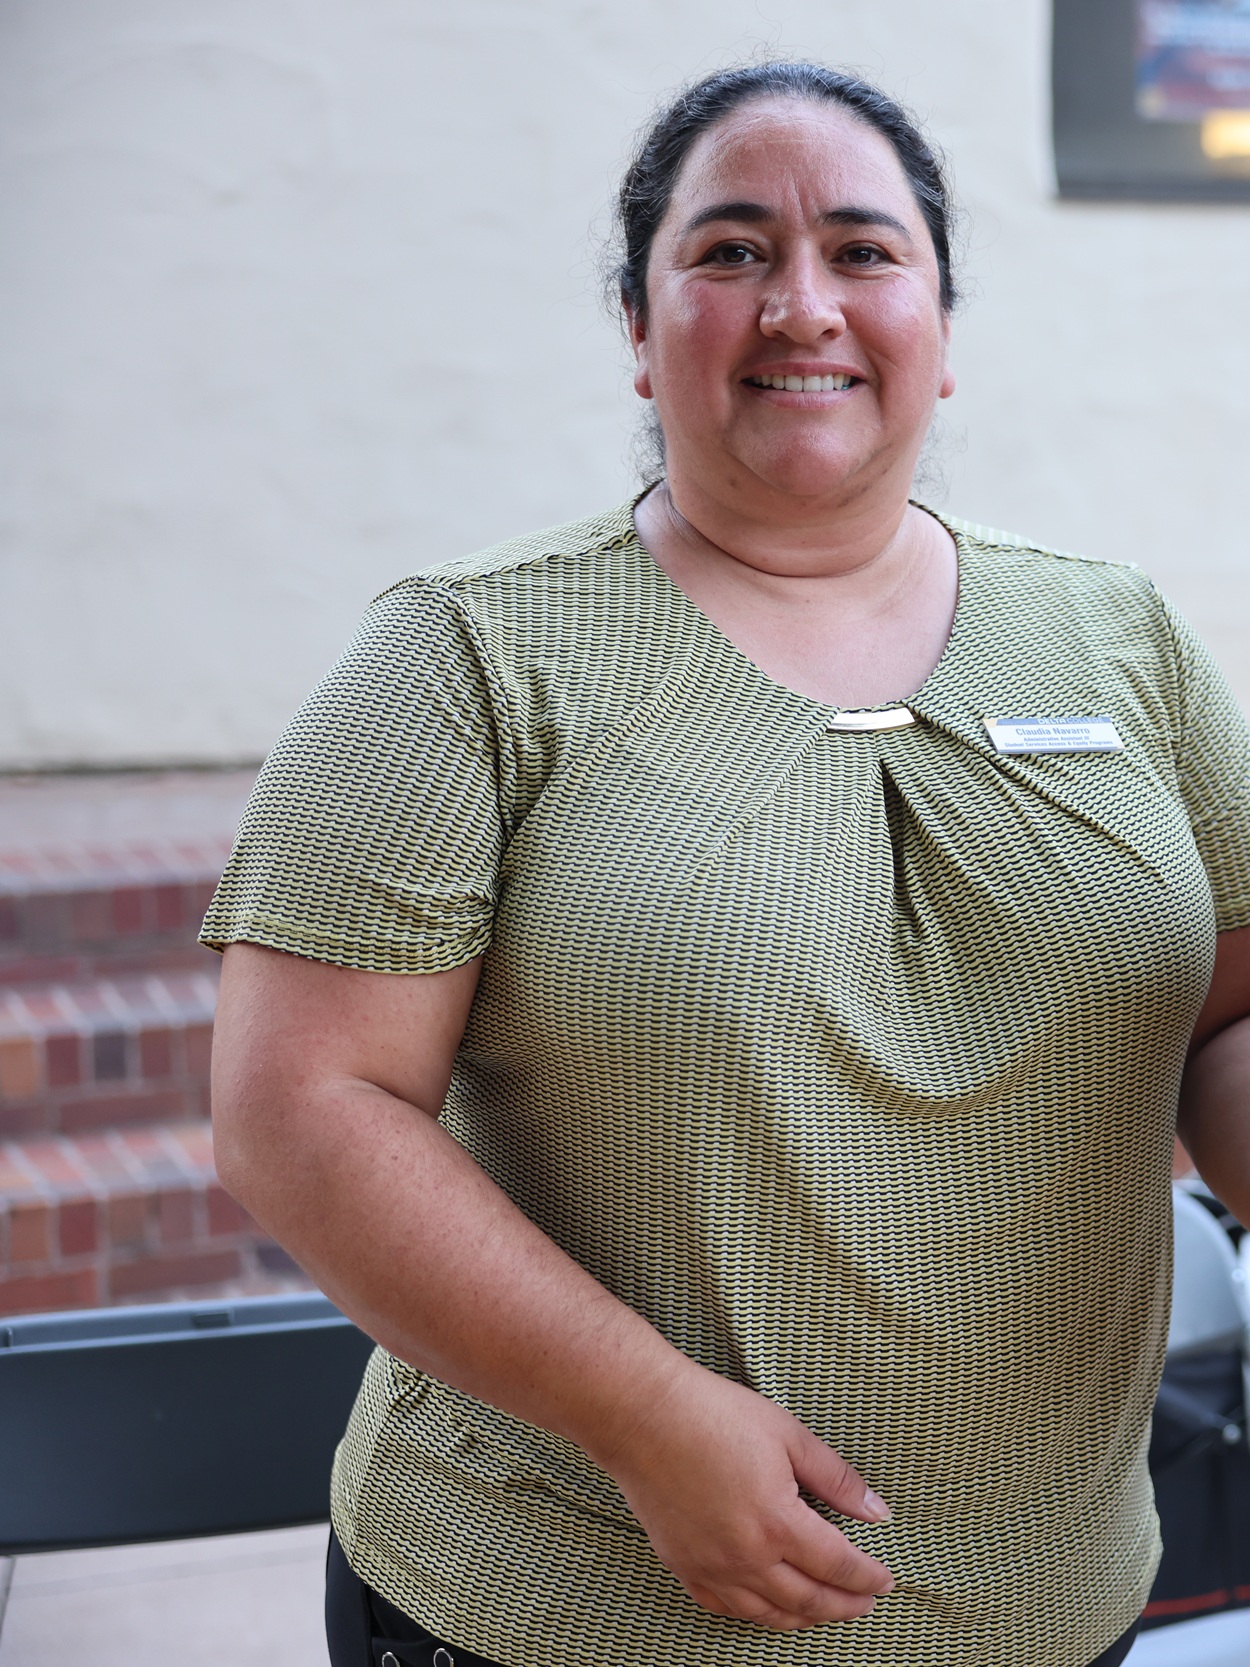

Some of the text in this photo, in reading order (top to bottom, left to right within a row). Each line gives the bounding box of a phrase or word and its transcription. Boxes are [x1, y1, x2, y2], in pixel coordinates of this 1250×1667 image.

[1037, 717, 1067, 725] DELTA
[1067, 716, 1104, 724] COLLEGE
[1015, 726, 1090, 736] Claudia Navarro
